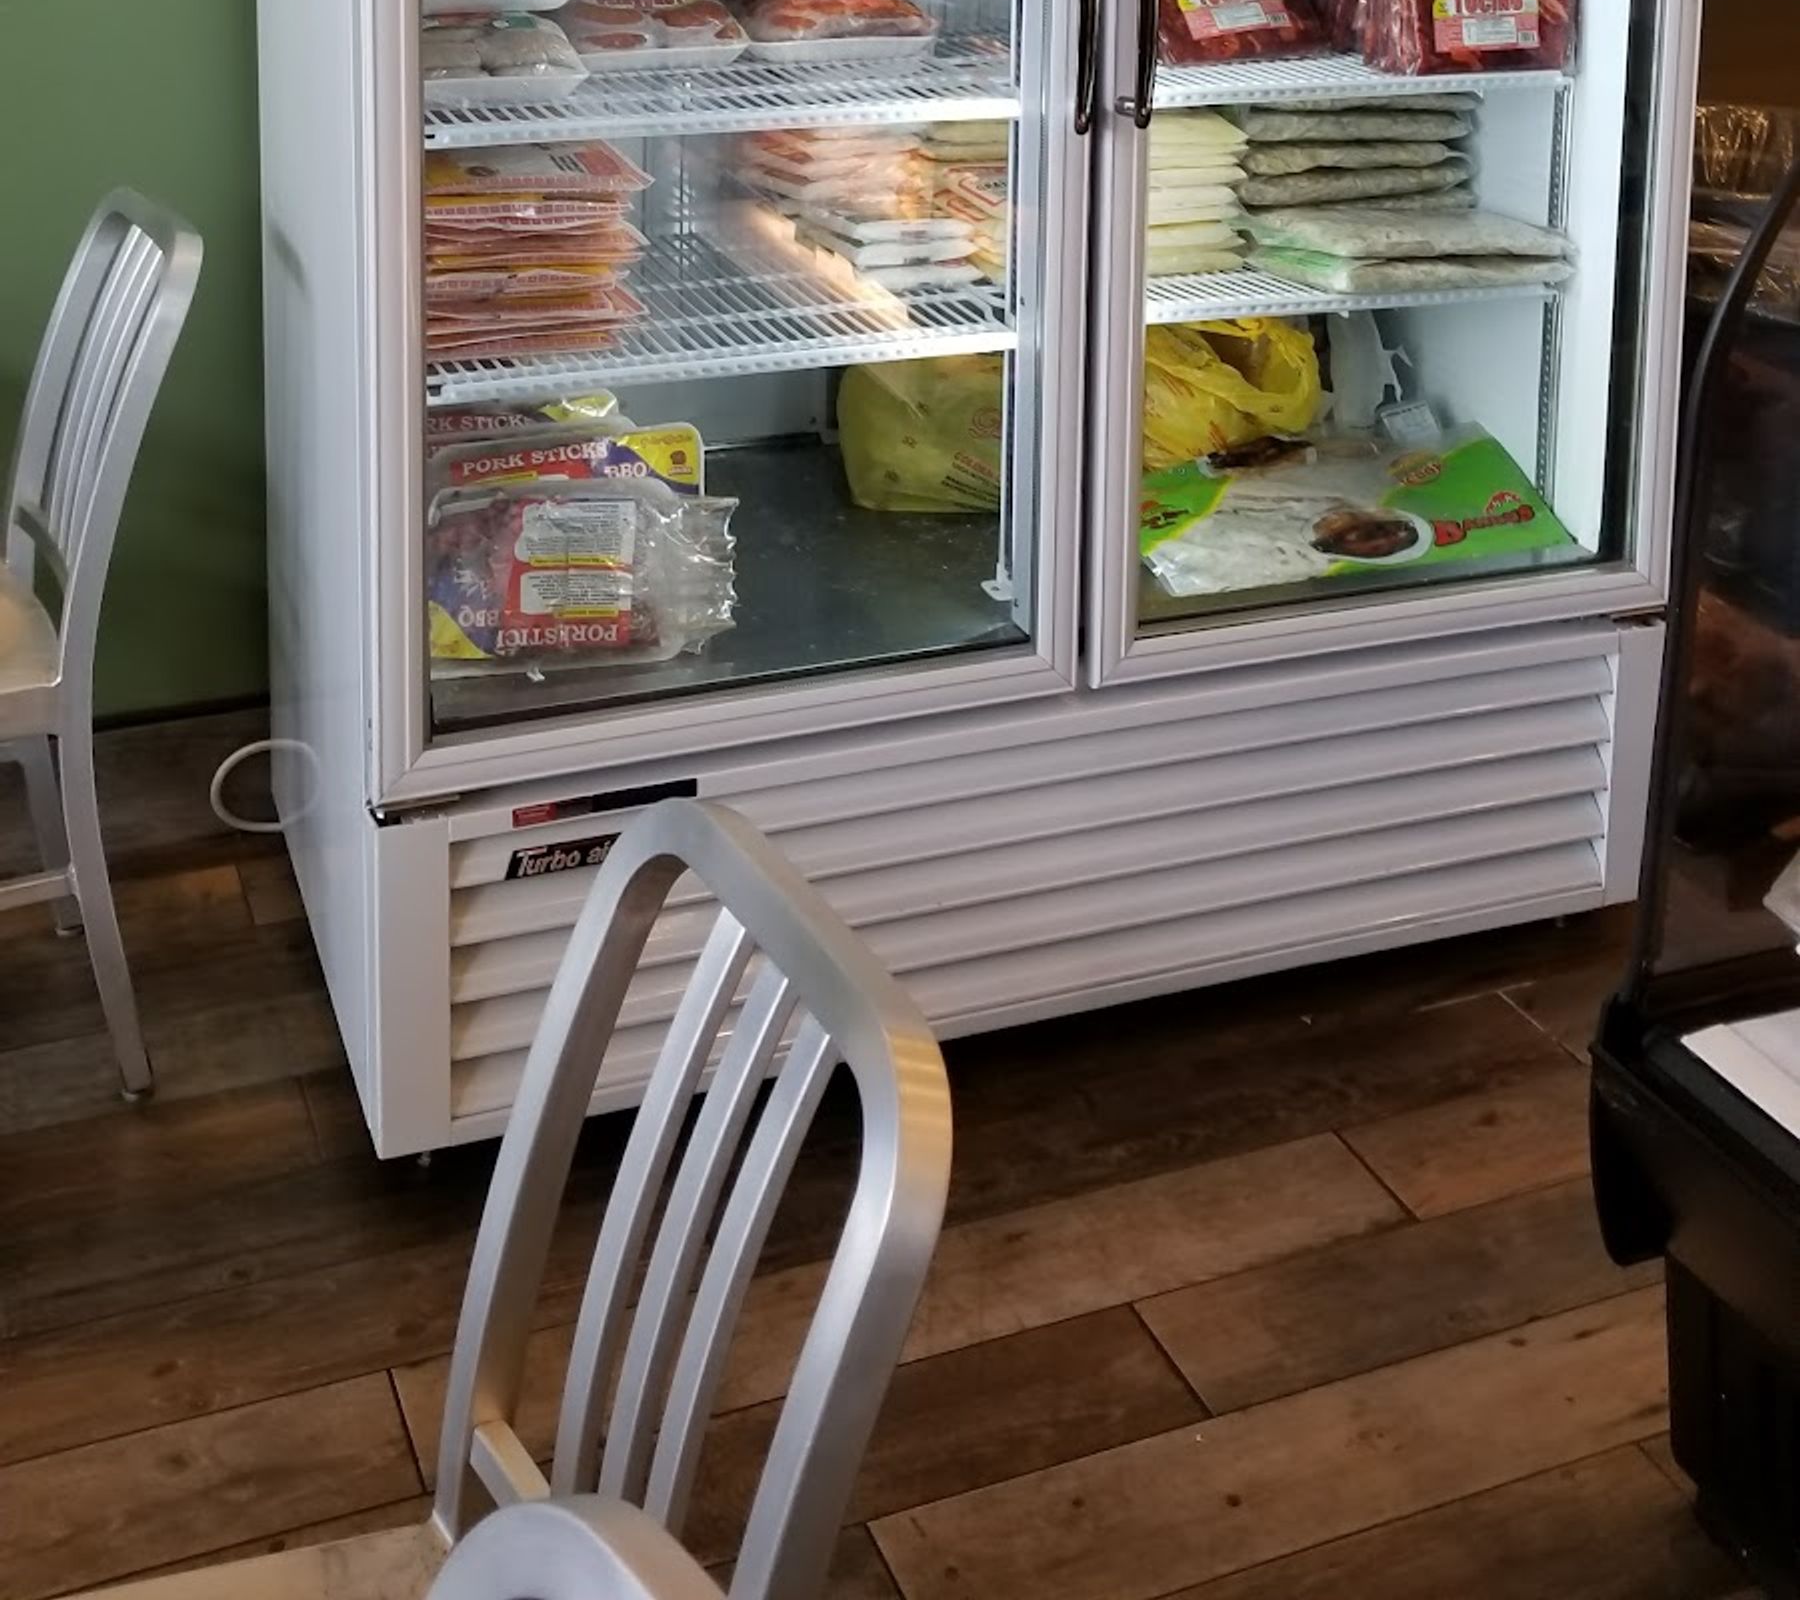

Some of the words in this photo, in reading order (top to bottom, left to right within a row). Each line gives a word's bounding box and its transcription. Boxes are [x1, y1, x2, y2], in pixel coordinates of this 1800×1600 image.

[461, 413, 531, 431] STICK
[462, 453, 524, 477] PORK
[531, 439, 609, 465] STICKS
[604, 461, 649, 479] BBQ
[496, 627, 561, 648] STIC
[516, 848, 581, 878] Turbo
[586, 840, 611, 865] ai
